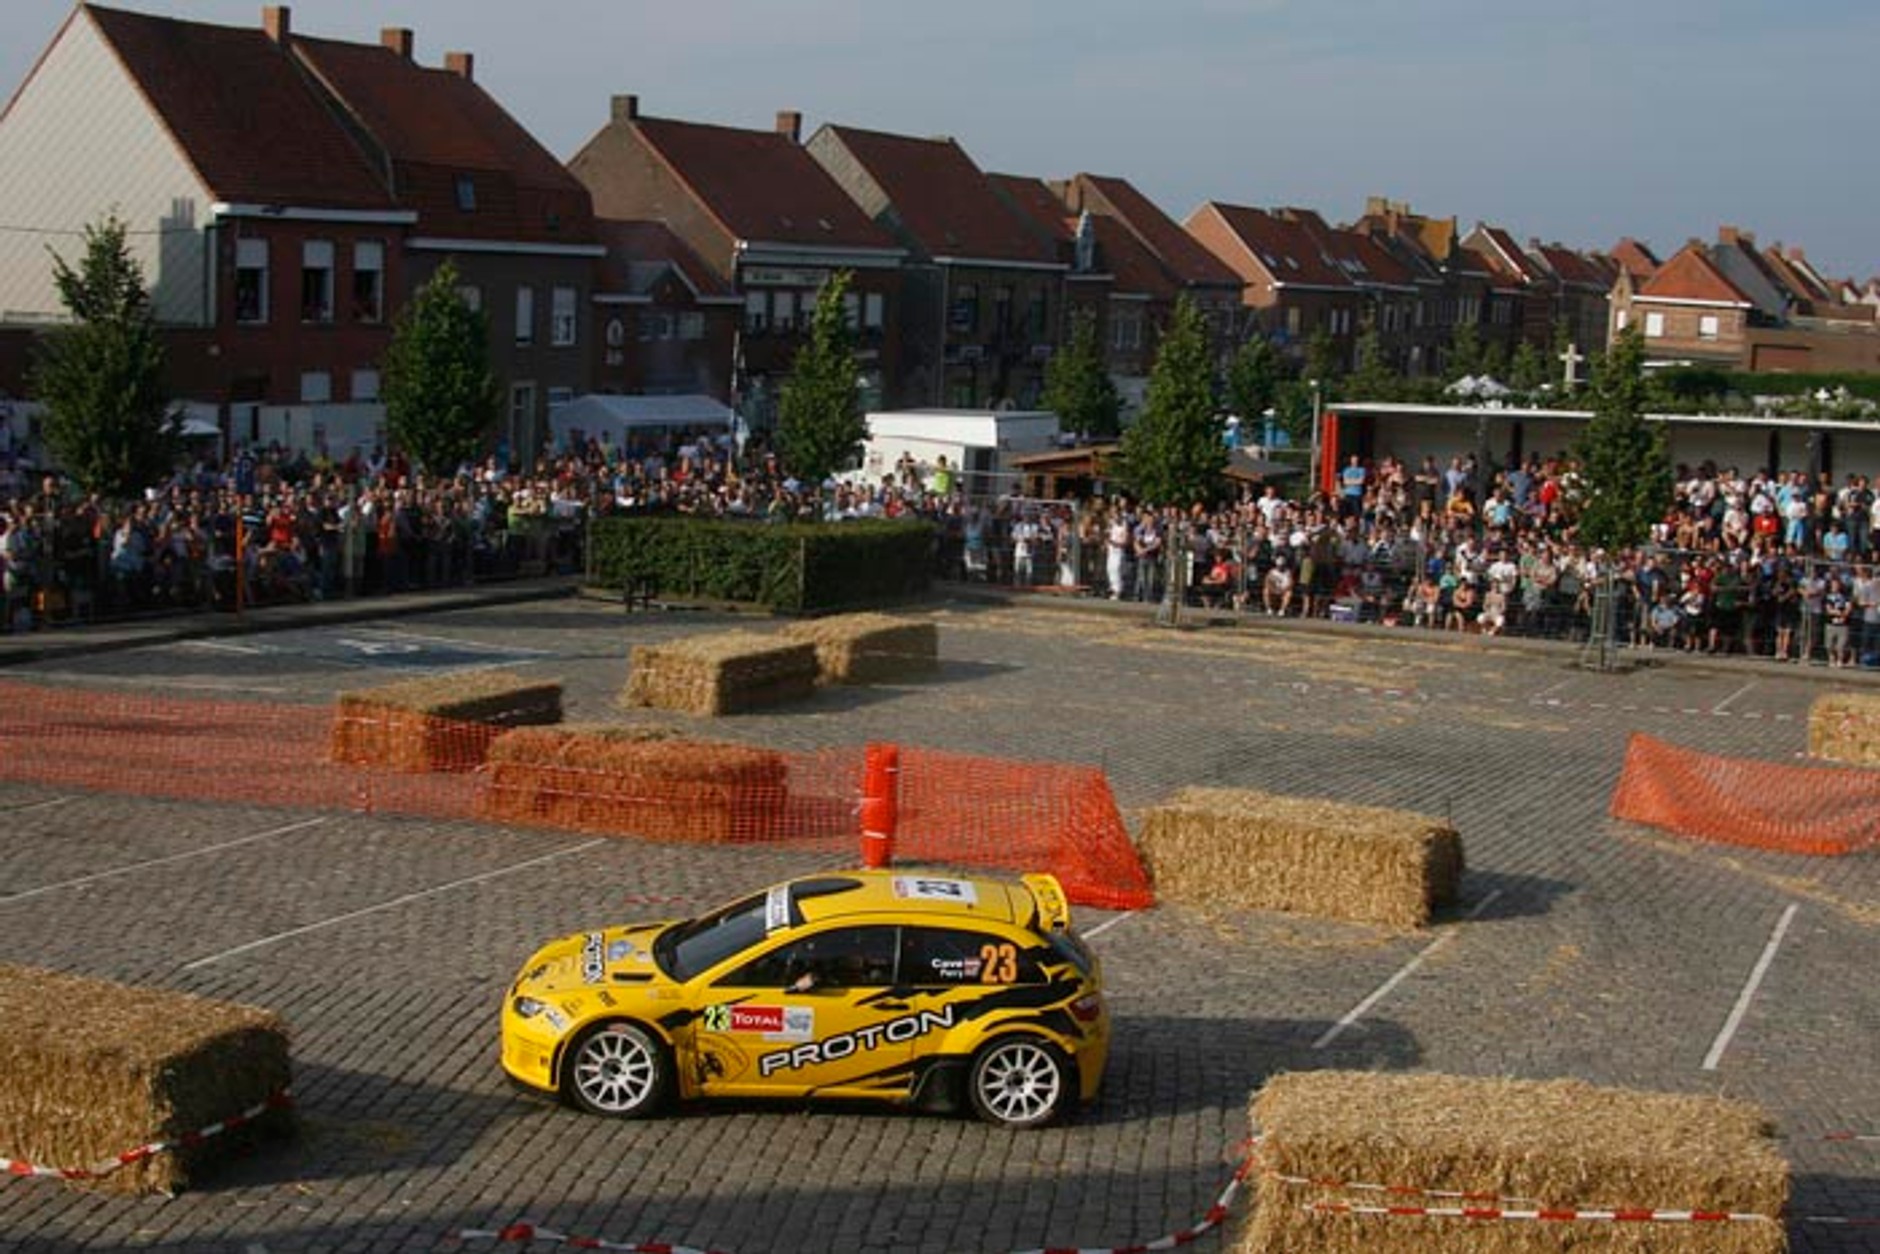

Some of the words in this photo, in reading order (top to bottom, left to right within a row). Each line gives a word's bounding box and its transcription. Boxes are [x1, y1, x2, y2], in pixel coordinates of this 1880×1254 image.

[980, 943, 1017, 983] 23
[705, 1006, 729, 1031] 23
[760, 1003, 954, 1077] PROTON
